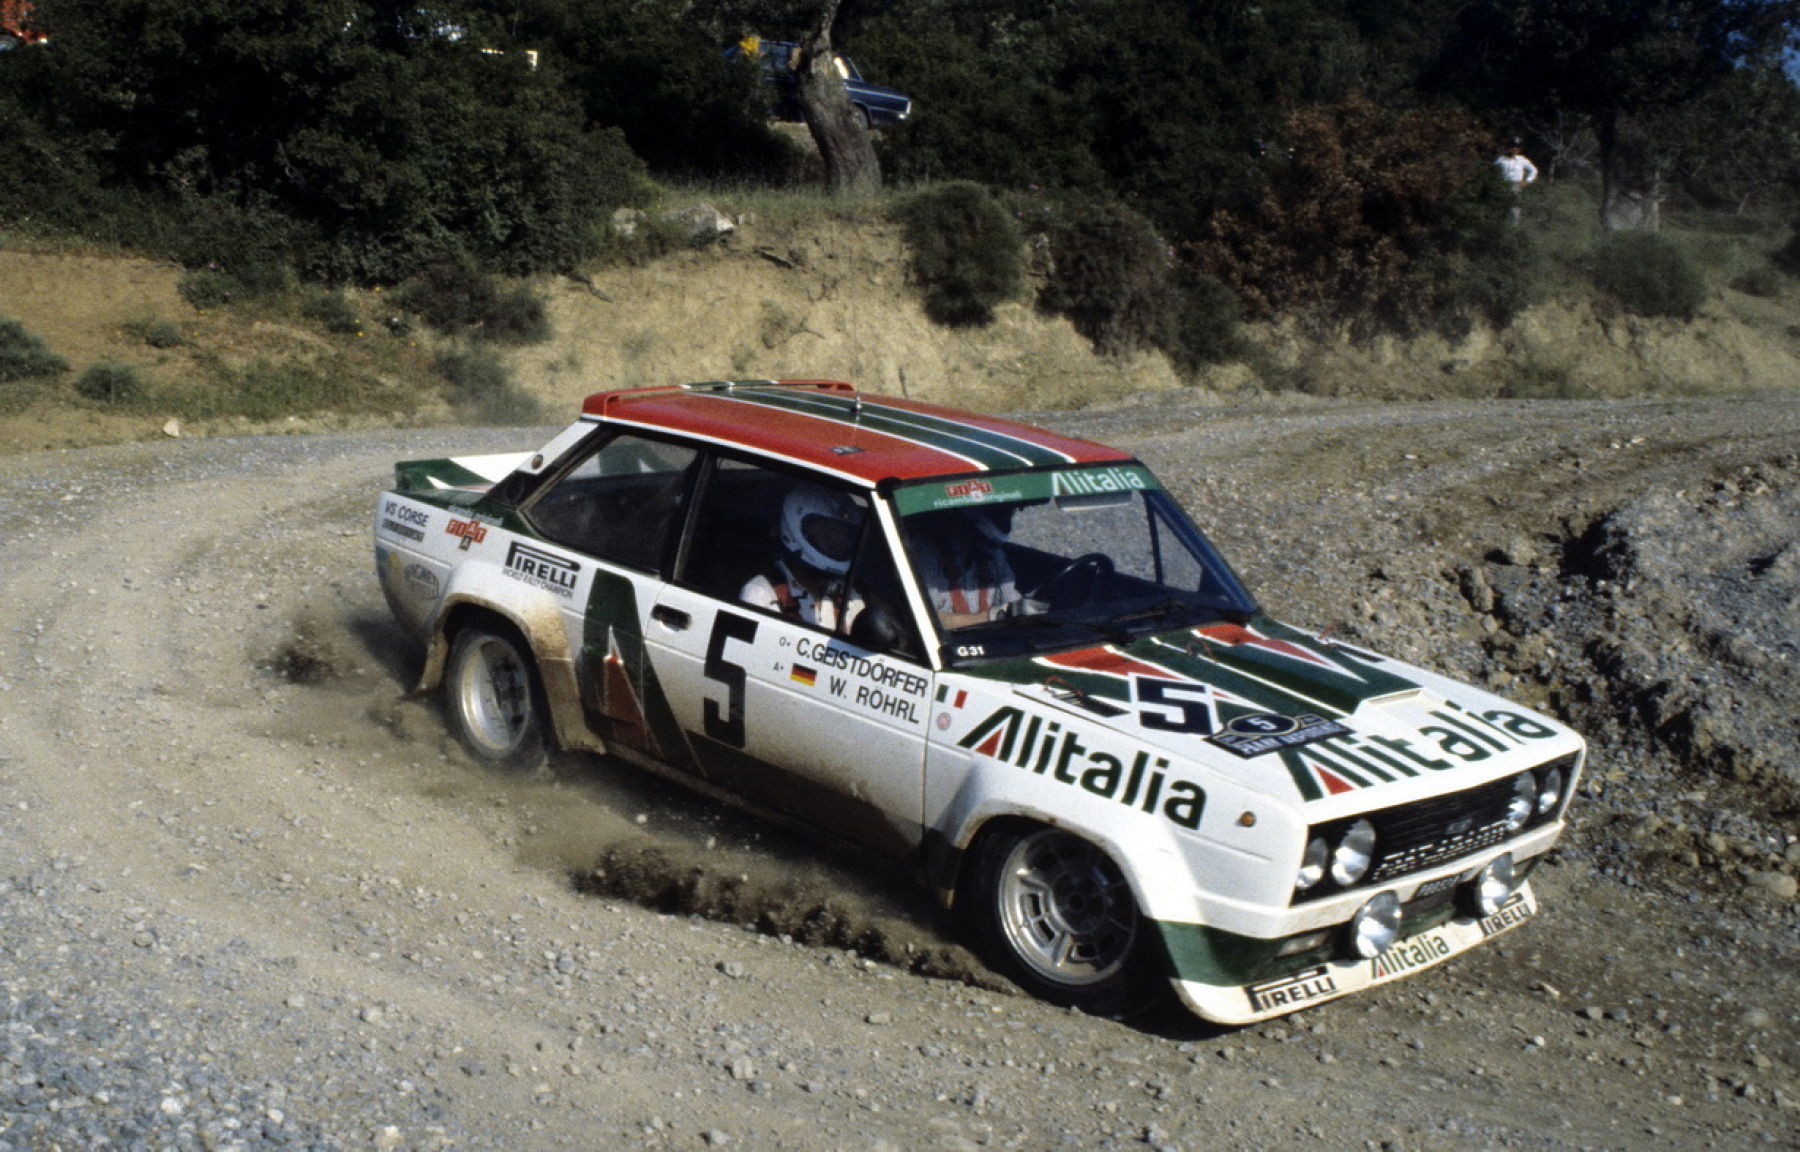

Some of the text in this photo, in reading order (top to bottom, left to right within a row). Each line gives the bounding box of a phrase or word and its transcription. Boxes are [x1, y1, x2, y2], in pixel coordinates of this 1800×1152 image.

[945, 479, 993, 498] FIAT
[1051, 468, 1145, 496] Alitalia
[398, 505, 430, 528] CORSE
[446, 519, 488, 543] FIAT
[505, 542, 581, 589] PIRELLI
[703, 609, 759, 749] 5
[856, 686, 919, 724] RÖHRL
[1136, 676, 1213, 736] 5
[1246, 717, 1277, 731] 5
[957, 705, 1208, 831] Alitalia
[1278, 700, 1558, 802] Alitalia
[1371, 935, 1450, 979] Alitalia
[1244, 966, 1337, 1013] PIRELLI
